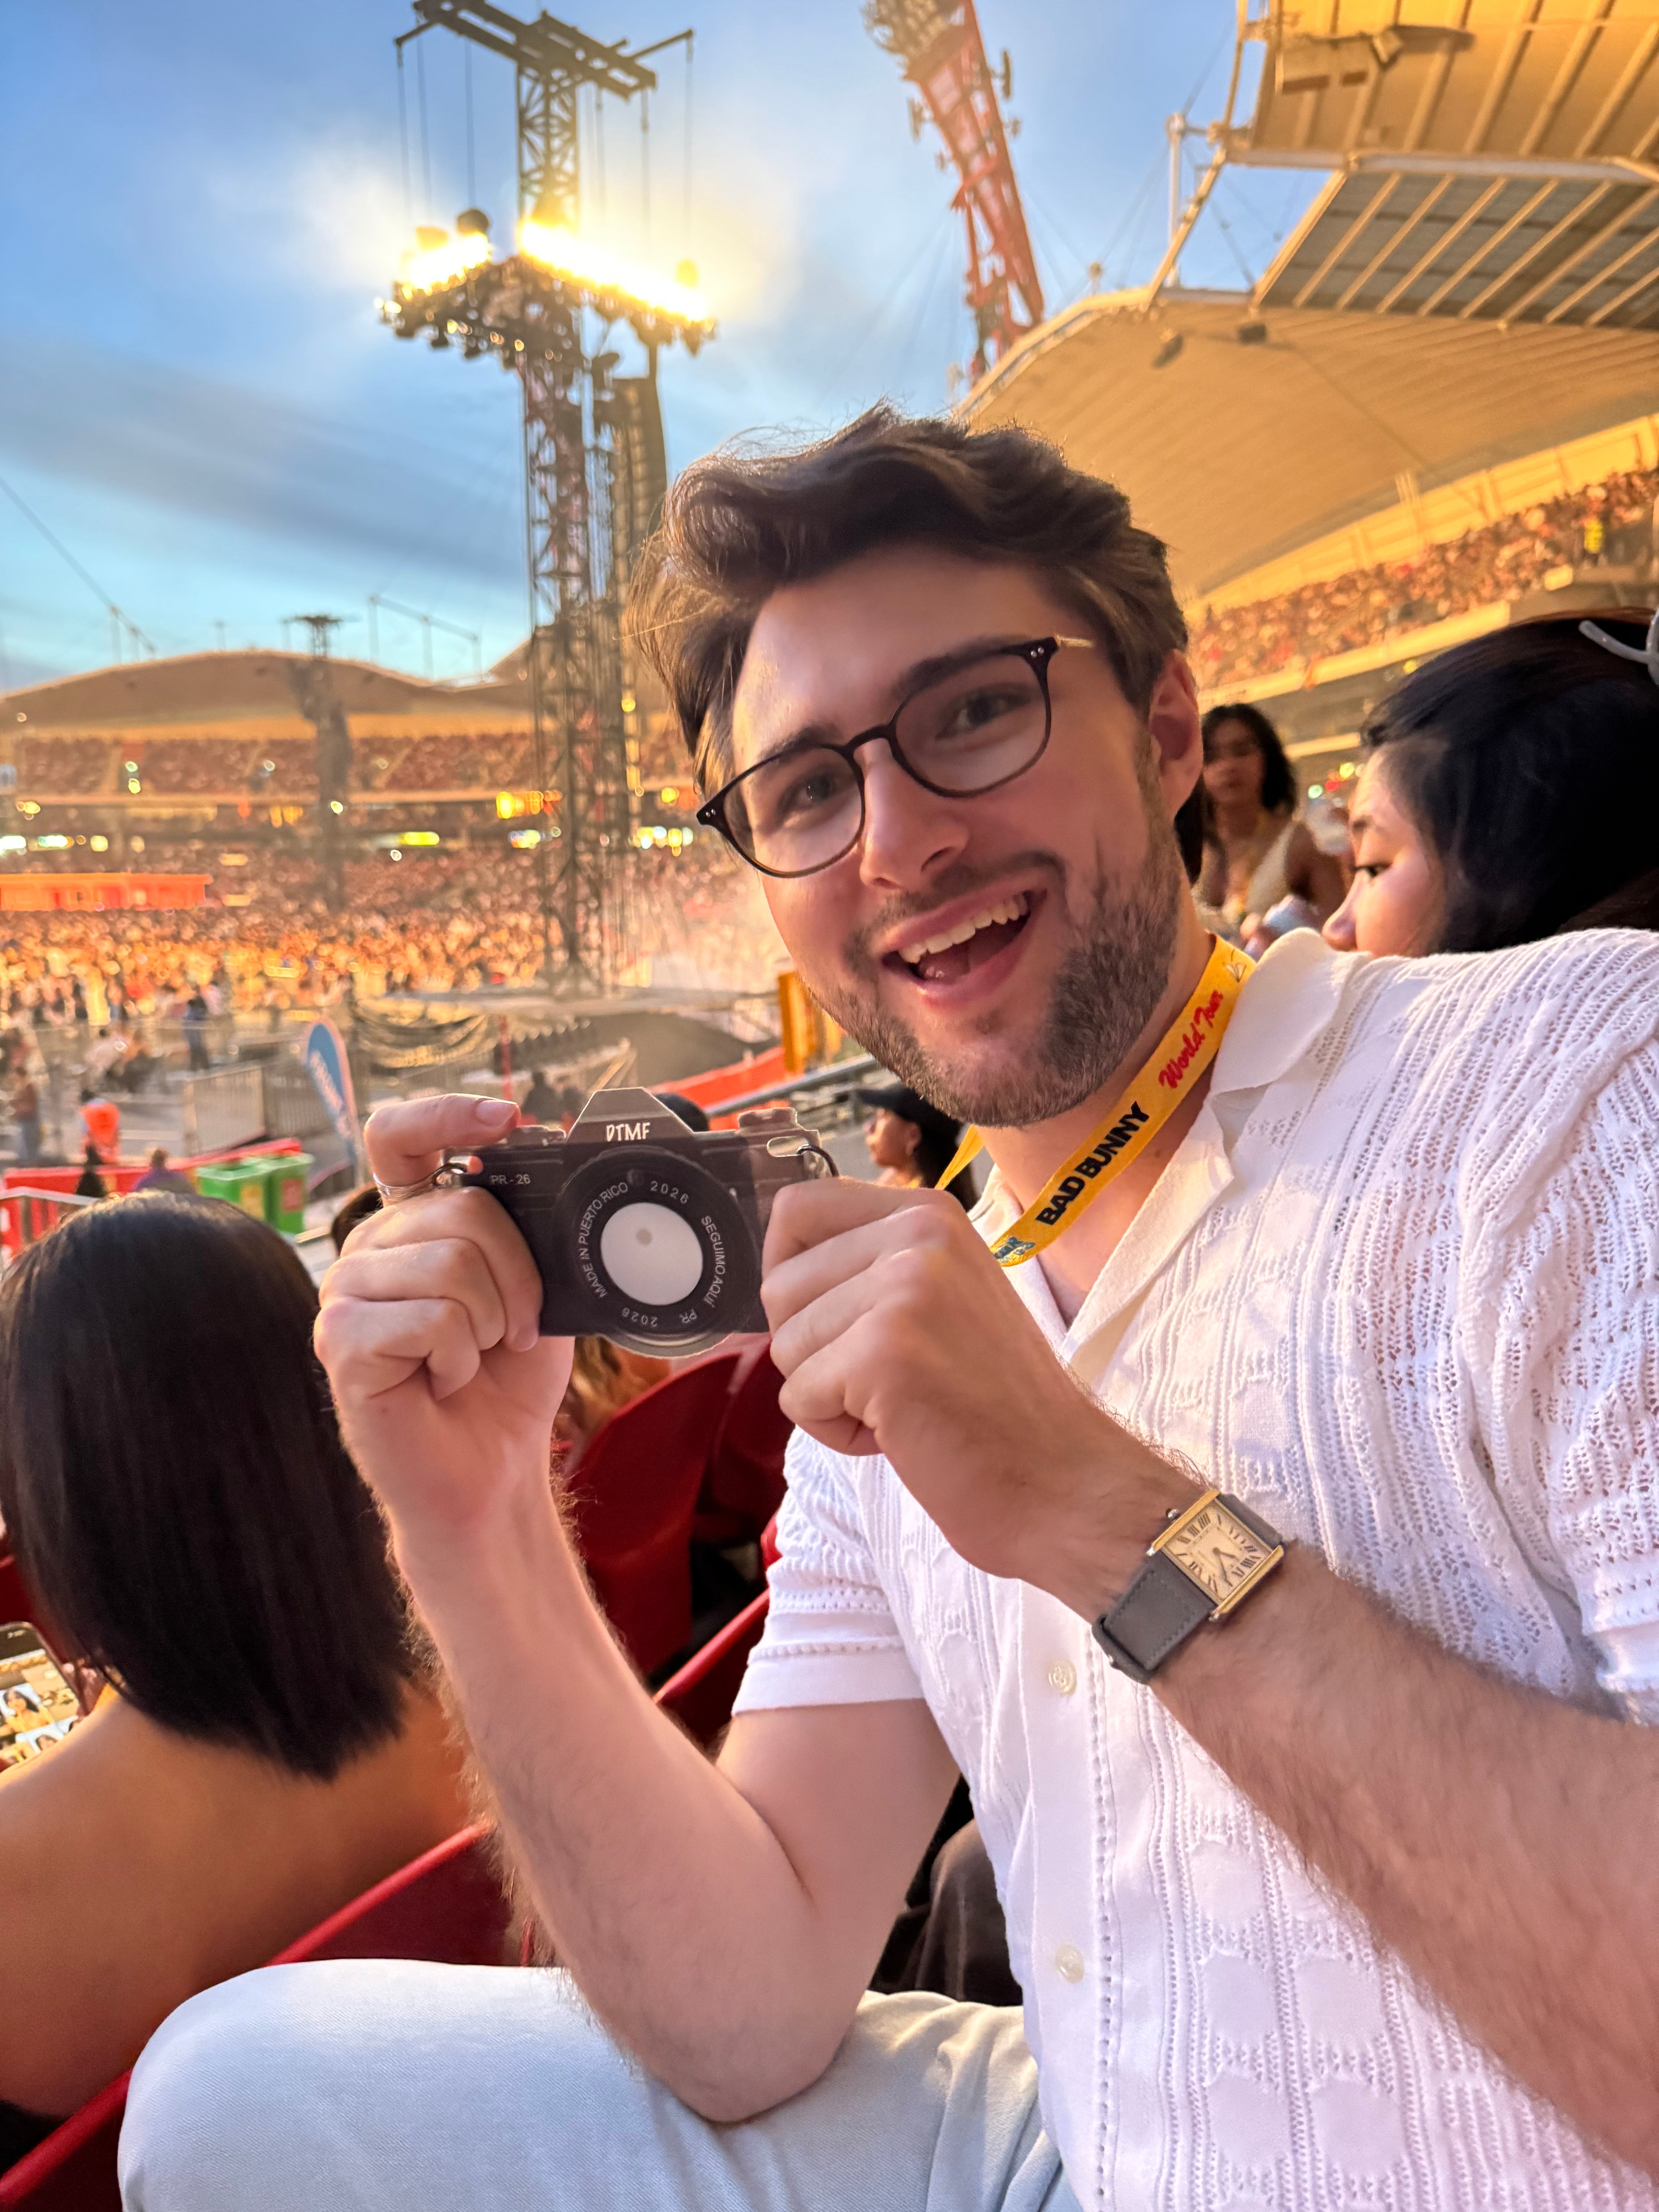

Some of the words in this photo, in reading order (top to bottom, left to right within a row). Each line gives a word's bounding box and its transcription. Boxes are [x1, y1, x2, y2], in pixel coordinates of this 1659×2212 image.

[606, 1122, 651, 1142] DTMF
[1035, 1176, 1085, 1226] BAD
[1074, 1101, 1150, 1179] BUNNY
[1158, 1022, 1206, 1089] World
[490, 1174, 531, 1185] PR-26
[599, 1182, 628, 1203] RICO
[650, 1180, 689, 1204] 2026
[578, 1199, 603, 1245] PUERTO
[579, 1248, 590, 1259] IN
[701, 1215, 726, 1275] SEGUIMO
[583, 1262, 608, 1298] MADE
[621, 1307, 658, 1328] 2026
[679, 1308, 697, 1324] PR
